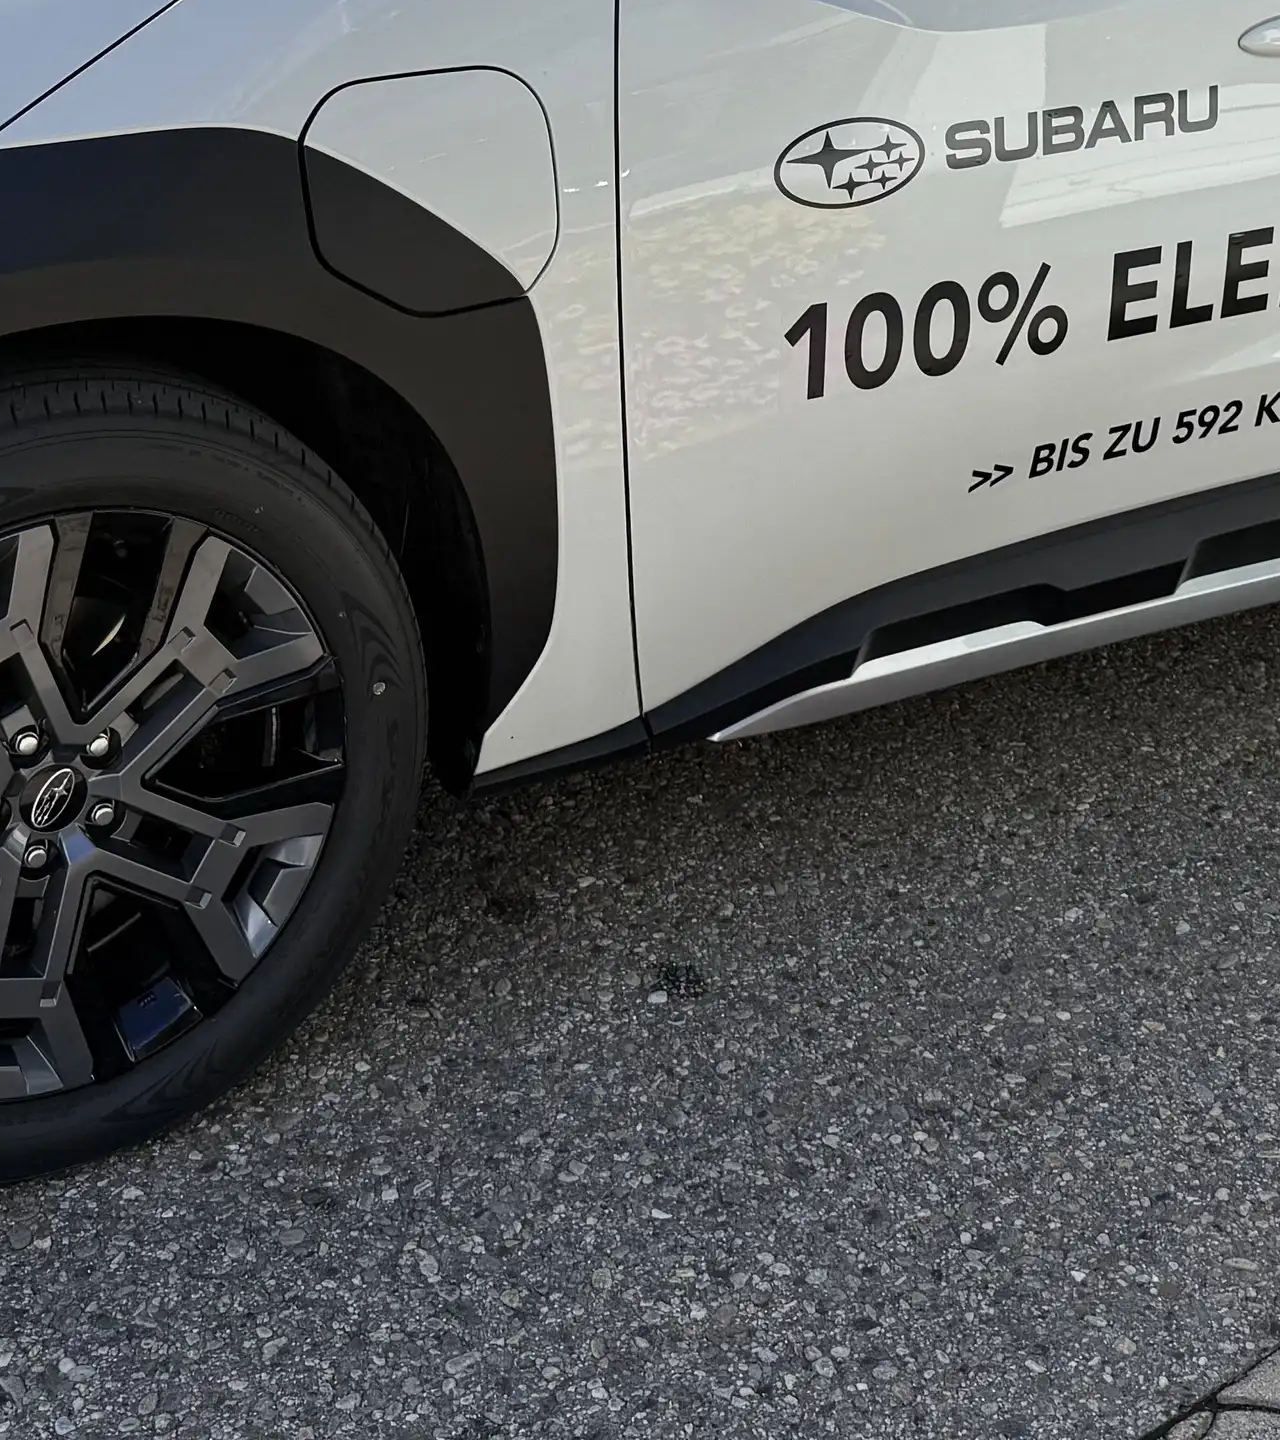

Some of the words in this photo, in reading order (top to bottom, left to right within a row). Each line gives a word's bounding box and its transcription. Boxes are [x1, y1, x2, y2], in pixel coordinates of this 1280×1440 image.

[944, 84, 1219, 170] SUBARU
[783, 261, 1069, 401] 100%
[1028, 432, 1093, 479] BIS
[1102, 416, 1161, 461] ZU
[1171, 399, 1244, 445] 592
